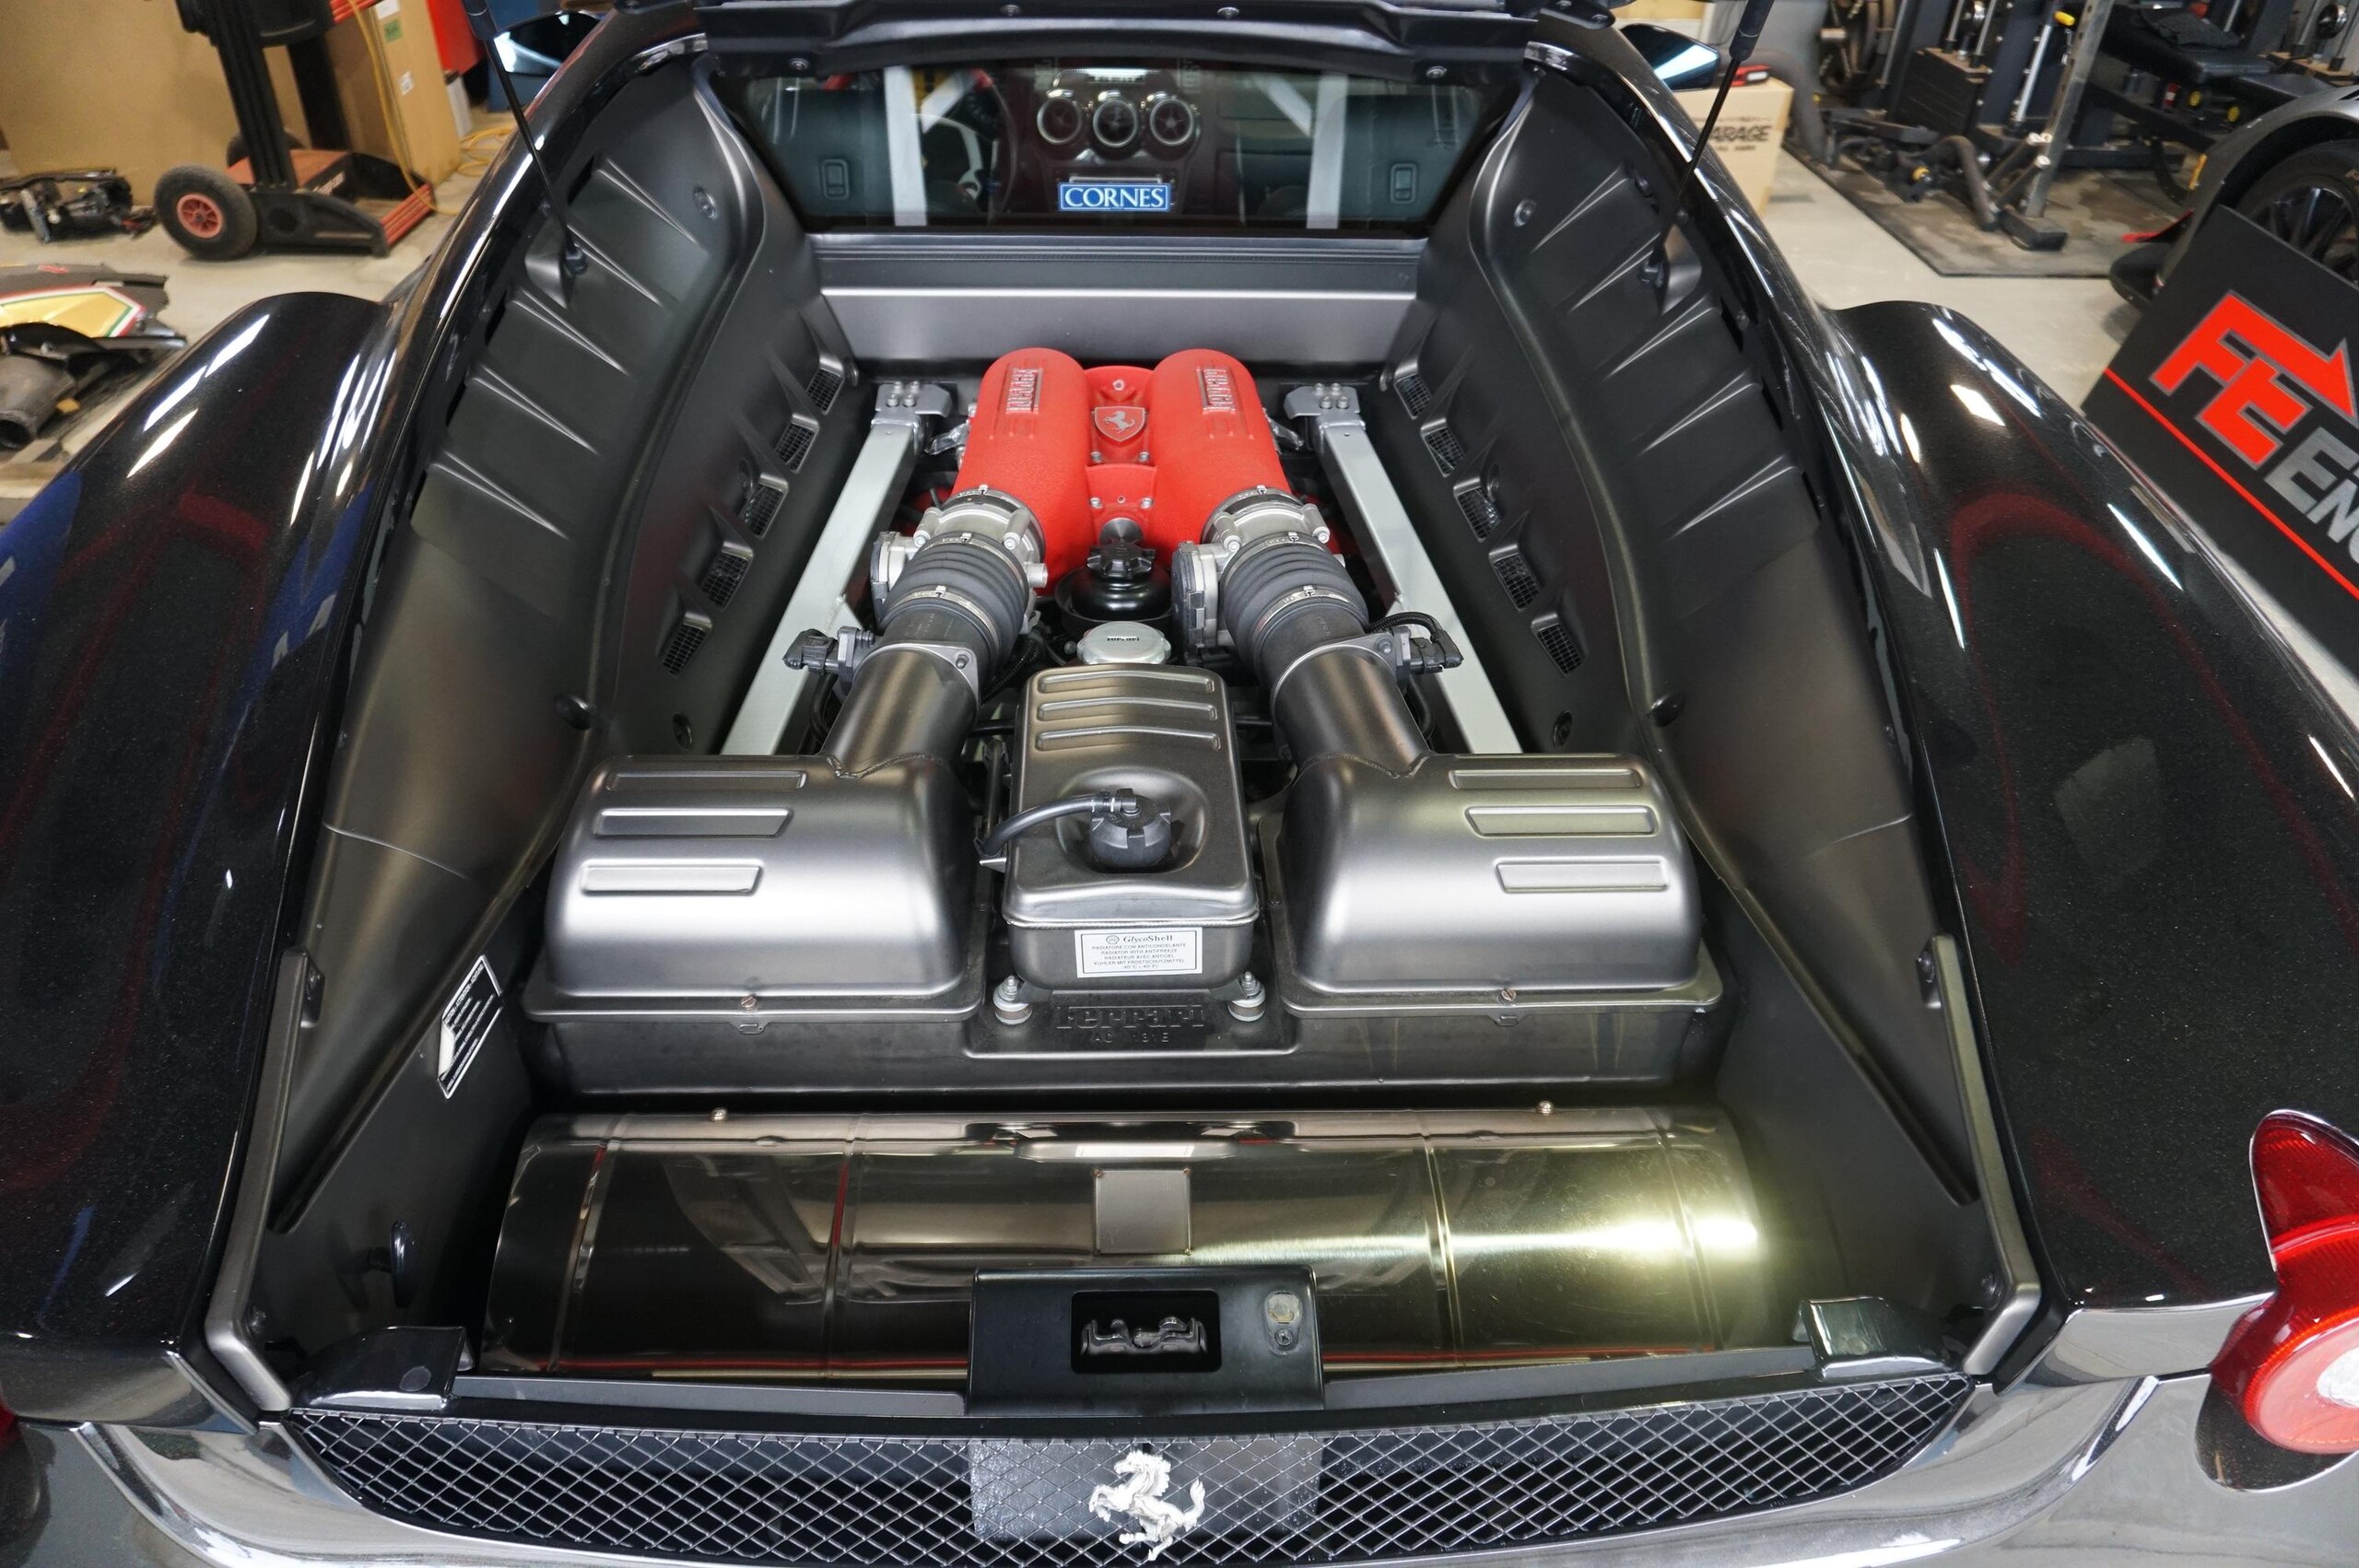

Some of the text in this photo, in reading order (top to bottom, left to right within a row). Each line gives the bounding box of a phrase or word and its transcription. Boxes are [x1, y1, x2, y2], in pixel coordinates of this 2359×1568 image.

[1710, 125, 1772, 143] ARAGE
[1064, 187, 1165, 207] CORNES
[2263, 427, 2359, 565] EN
[1122, 934, 1173, 943] GlycoShell
[1056, 1005, 1204, 1029] Ferrari
